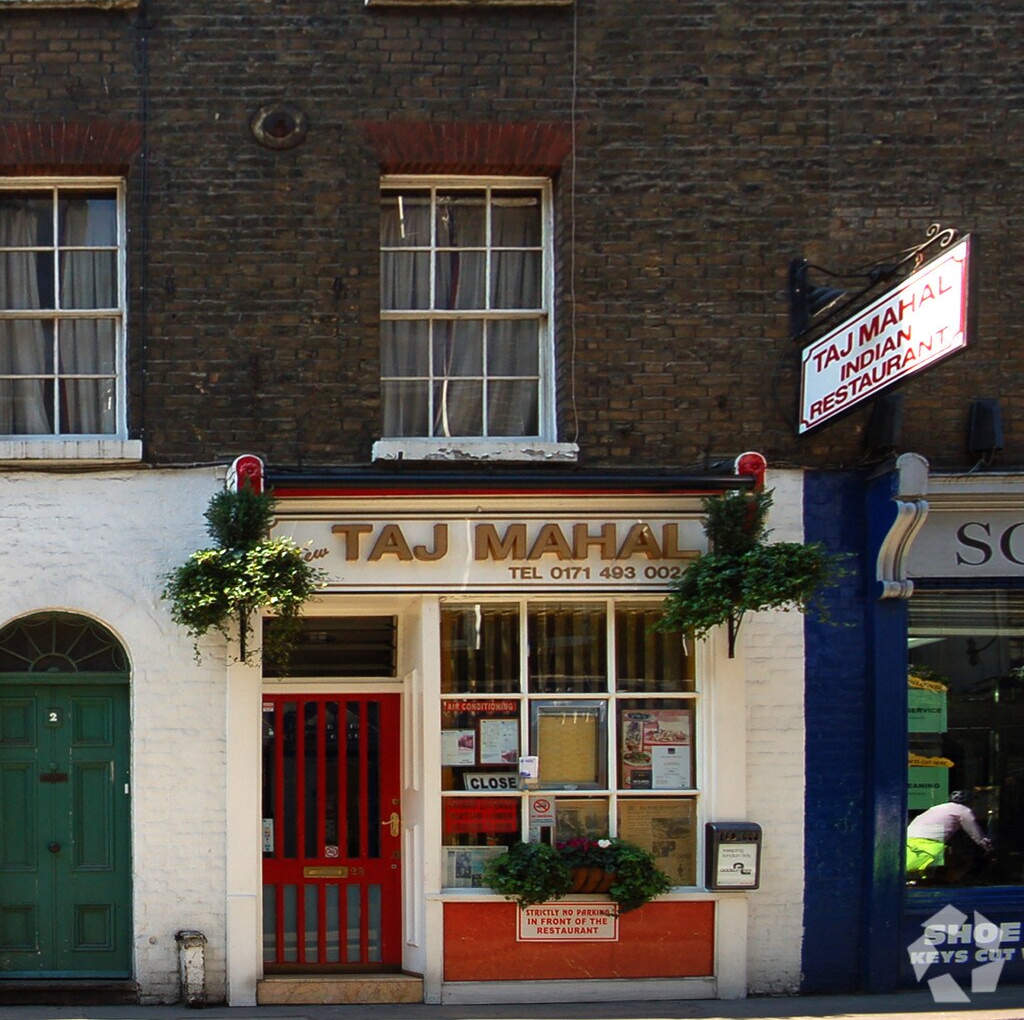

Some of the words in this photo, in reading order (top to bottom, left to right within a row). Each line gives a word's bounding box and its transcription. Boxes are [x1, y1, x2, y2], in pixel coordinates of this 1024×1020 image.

[813, 332, 853, 373] TAJ
[859, 276, 952, 346] MAHAL
[840, 325, 911, 381] INDIAN
[810, 326, 949, 420] RESTAURANT
[331, 523, 448, 562] TAJ
[474, 523, 702, 562] MAHAL
[508, 566, 543, 580] TEL
[550, 566, 591, 580] 0171
[600, 566, 636, 580] 493
[447, 702, 460, 710] AIR
[461, 702, 514, 711] CONDITIONING
[49, 712, 58, 722] 2
[470, 777, 516, 789] CLOSE
[924, 922, 1021, 946] SHOE
[910, 950, 968, 964] KEYS
[974, 948, 1016, 962] CUT
